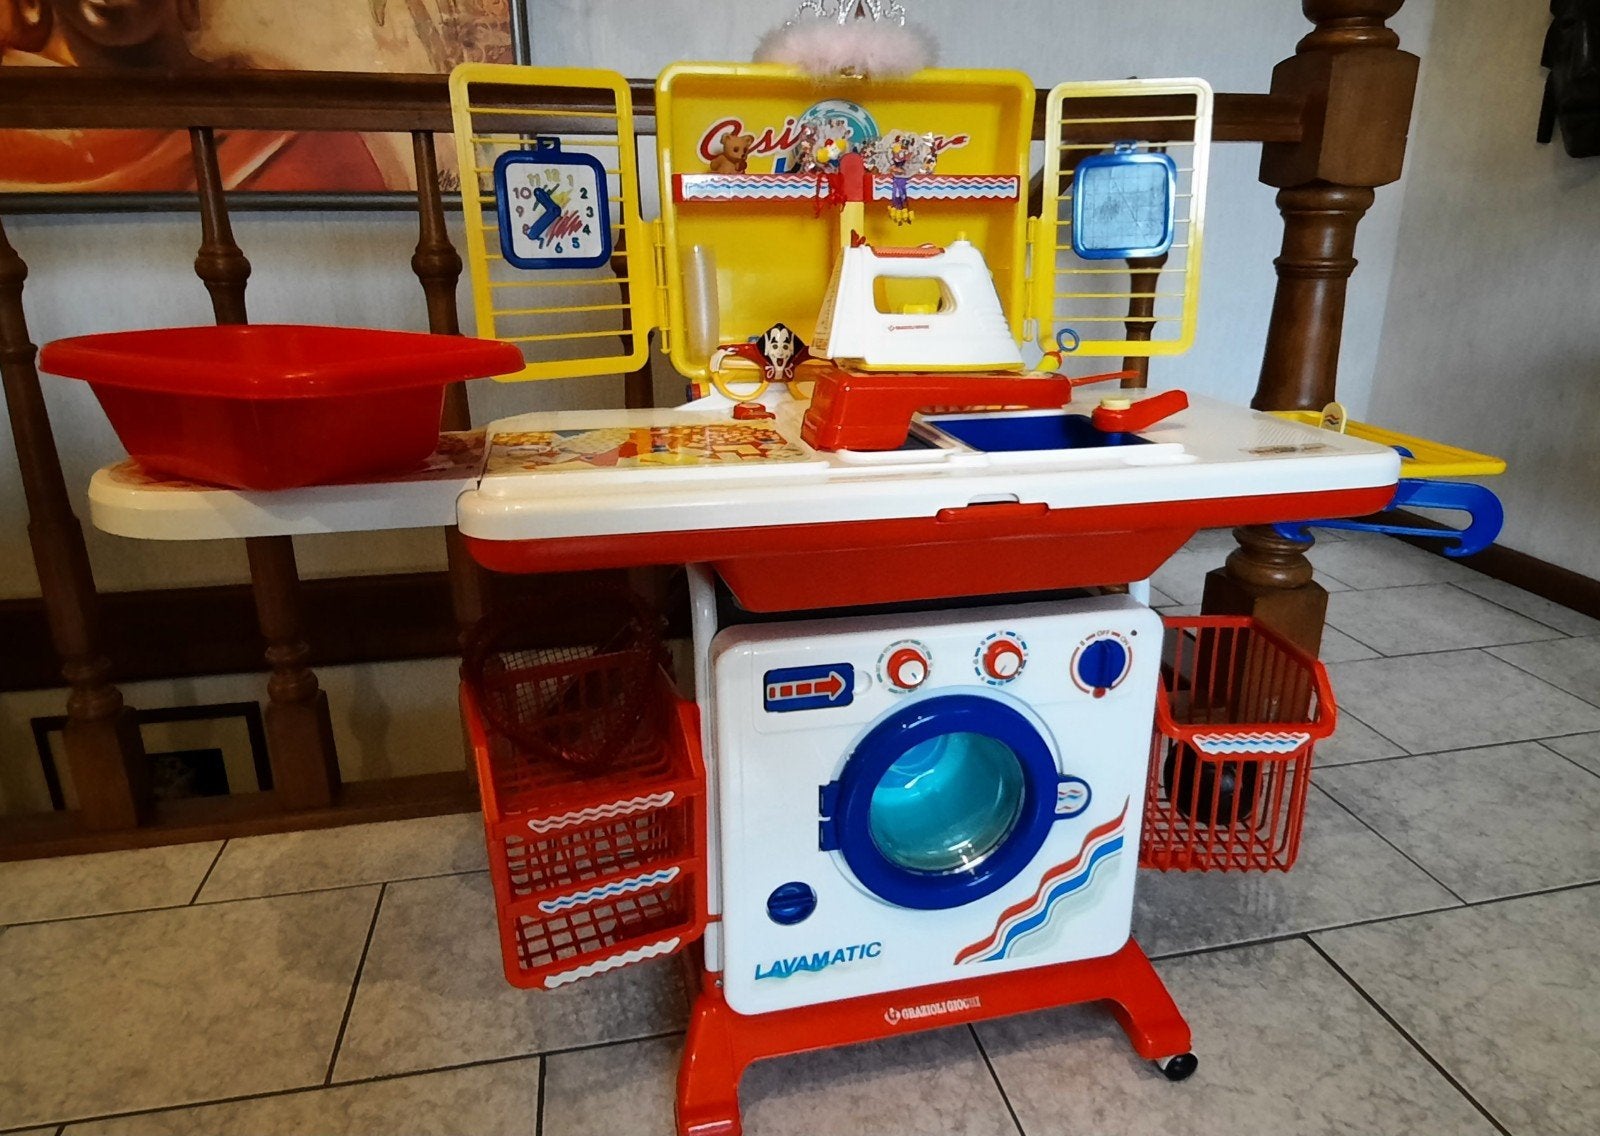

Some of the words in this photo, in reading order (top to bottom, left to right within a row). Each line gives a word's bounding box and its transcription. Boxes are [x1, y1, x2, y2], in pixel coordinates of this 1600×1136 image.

[527, 173, 541, 187] 11
[544, 168, 560, 182] 12
[566, 174, 574, 187] 1
[512, 186, 532, 199] 10
[579, 187, 588, 199] 2
[515, 205, 524, 218] 9
[586, 206, 594, 218] 3
[582, 223, 591, 236] 4
[554, 242, 563, 253] 6
[571, 237, 580, 249] 5
[754, 941, 882, 980] LAVAMATIC
